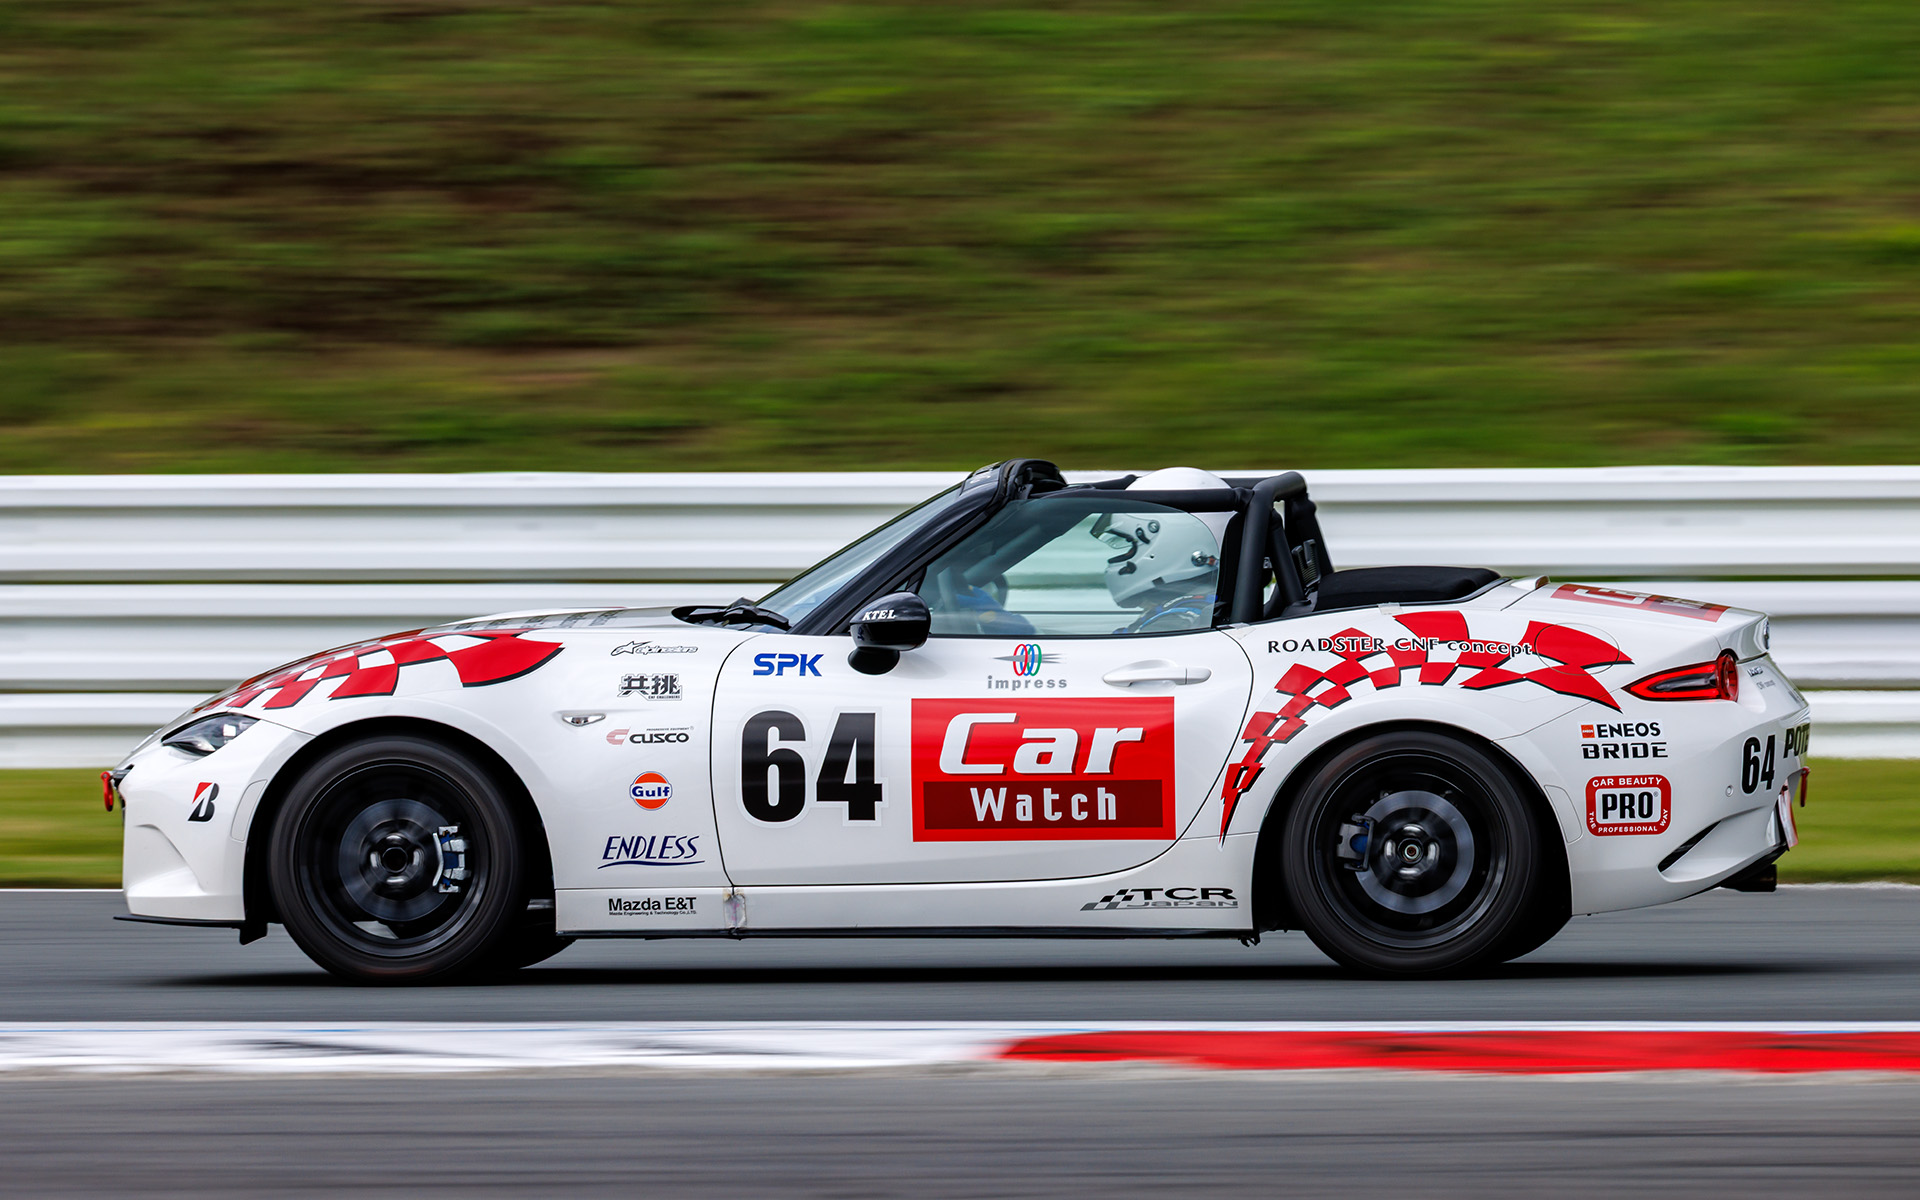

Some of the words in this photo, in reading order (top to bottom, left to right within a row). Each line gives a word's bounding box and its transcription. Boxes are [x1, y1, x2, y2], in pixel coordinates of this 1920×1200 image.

[862, 609, 896, 621] KTEL
[1268, 637, 1387, 653] ROADSTER
[1394, 637, 1439, 650] CNF
[1447, 640, 1532, 657] concept
[753, 653, 824, 677] SPK
[621, 675, 681, 695] 共挑
[987, 675, 1068, 691] impress
[629, 733, 690, 744] CUSCO
[1596, 721, 1661, 738] ENEOS
[939, 713, 1147, 775] Car
[1580, 742, 1668, 759] BRIDE
[741, 710, 883, 822] 64
[1741, 734, 1776, 794] 64
[631, 785, 670, 797] Gulf
[1592, 778, 1614, 788] CAR
[1618, 777, 1663, 785] BEAUTY
[970, 787, 1117, 822] Watch
[1602, 791, 1653, 820] PRO
[1588, 811, 1597, 829] THE
[1597, 825, 1658, 833] PROFESSIONAL
[1660, 808, 1669, 827] WAY
[602, 835, 700, 860] ENDLESS
[608, 897, 661, 911] Mazda
[665, 896, 697, 910] E&T
[1129, 887, 1237, 900] TCR
